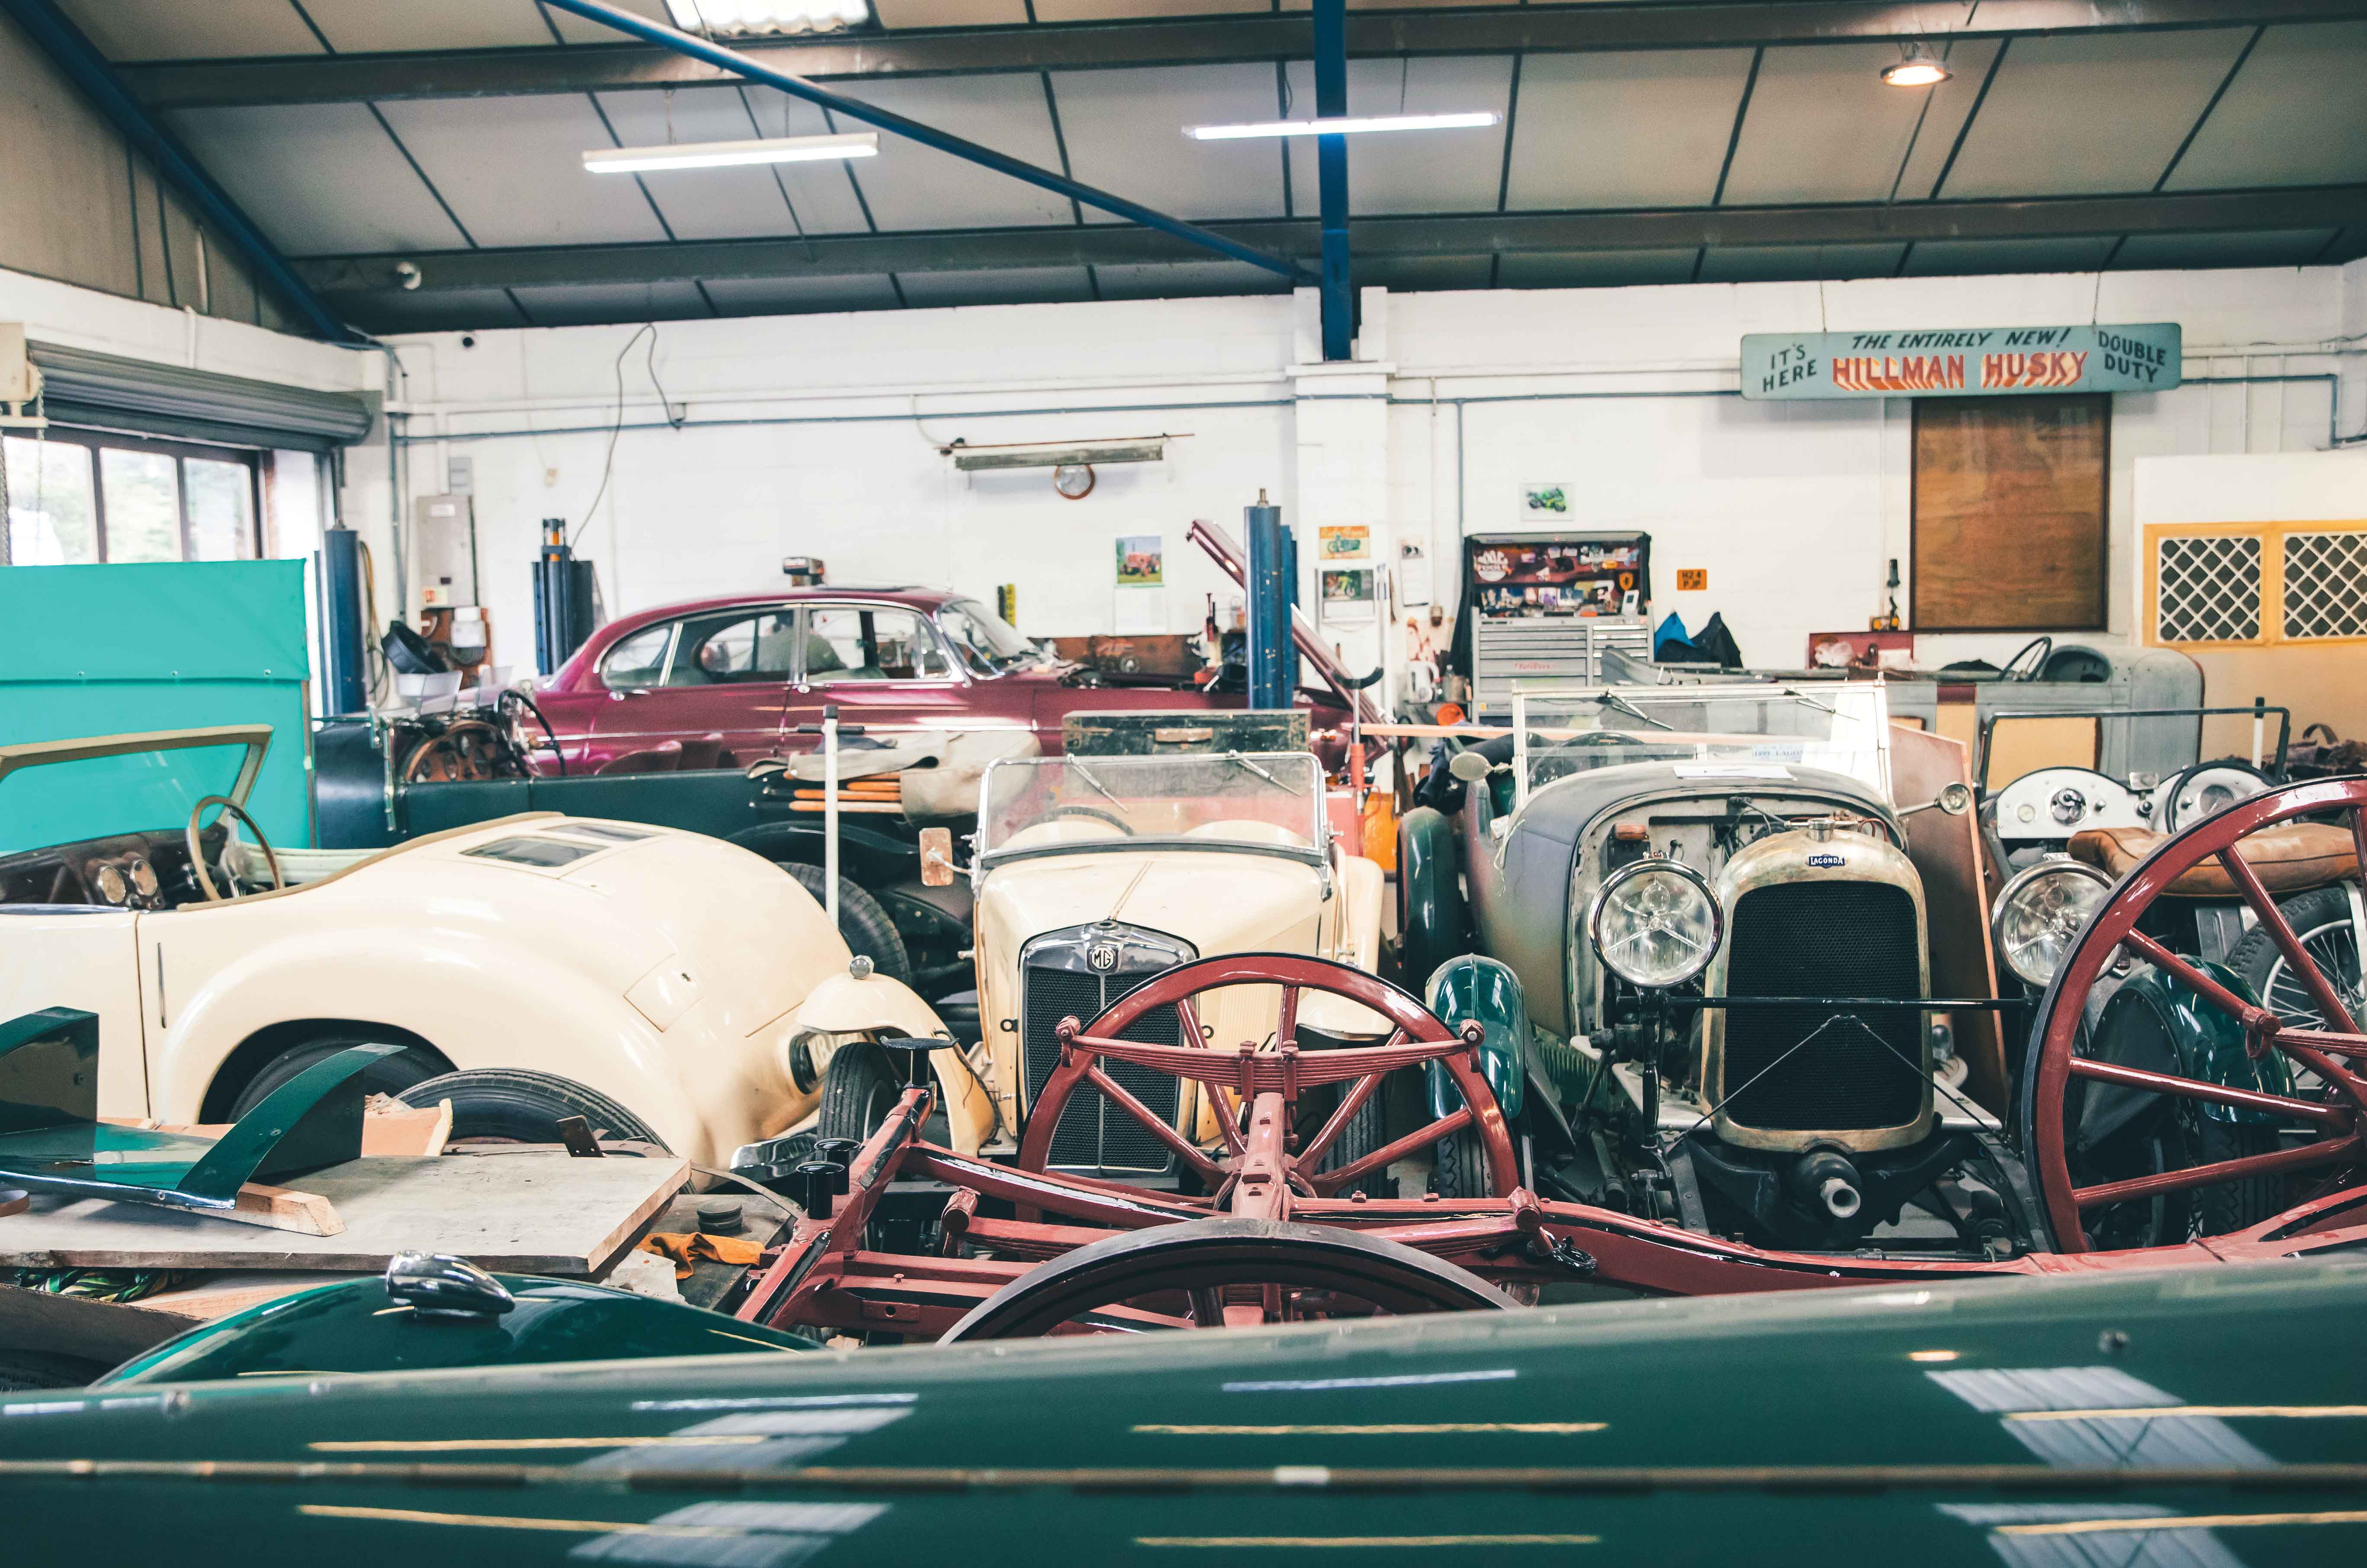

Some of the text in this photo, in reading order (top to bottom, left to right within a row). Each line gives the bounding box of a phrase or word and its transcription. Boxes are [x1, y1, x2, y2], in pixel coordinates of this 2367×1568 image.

[1852, 326, 2072, 349] THE ENTIRELY NEW!
[2098, 330, 2166, 366] DOUBLE
[1771, 343, 1806, 370] IT'S
[1832, 351, 2089, 391] HILLMAN HUSKY
[2104, 353, 2159, 384] DUTY
[1762, 358, 1817, 393] HERE
[1810, 856, 1844, 865] LAGONDA
[1093, 949, 1112, 968] MG
